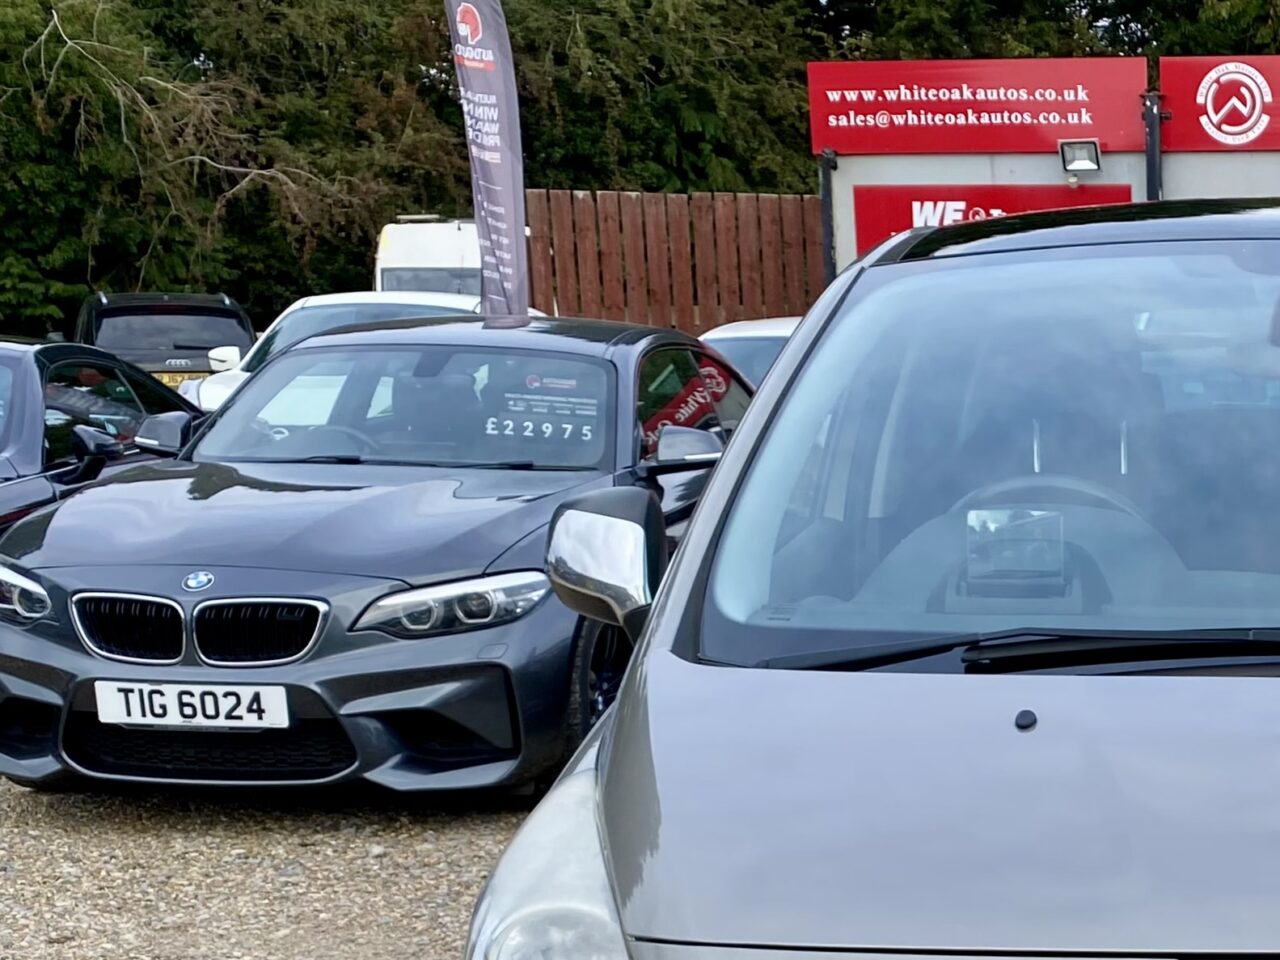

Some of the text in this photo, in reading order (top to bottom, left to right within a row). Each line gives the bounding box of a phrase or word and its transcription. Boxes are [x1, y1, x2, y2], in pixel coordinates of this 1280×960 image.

[826, 84, 1089, 102] www.whiteoakautos.co.uk
[828, 108, 1092, 128] sales@whiteoakautos.co.uk
[485, 417, 592, 440] £22975
[117, 687, 266, 721] TIG 6024
